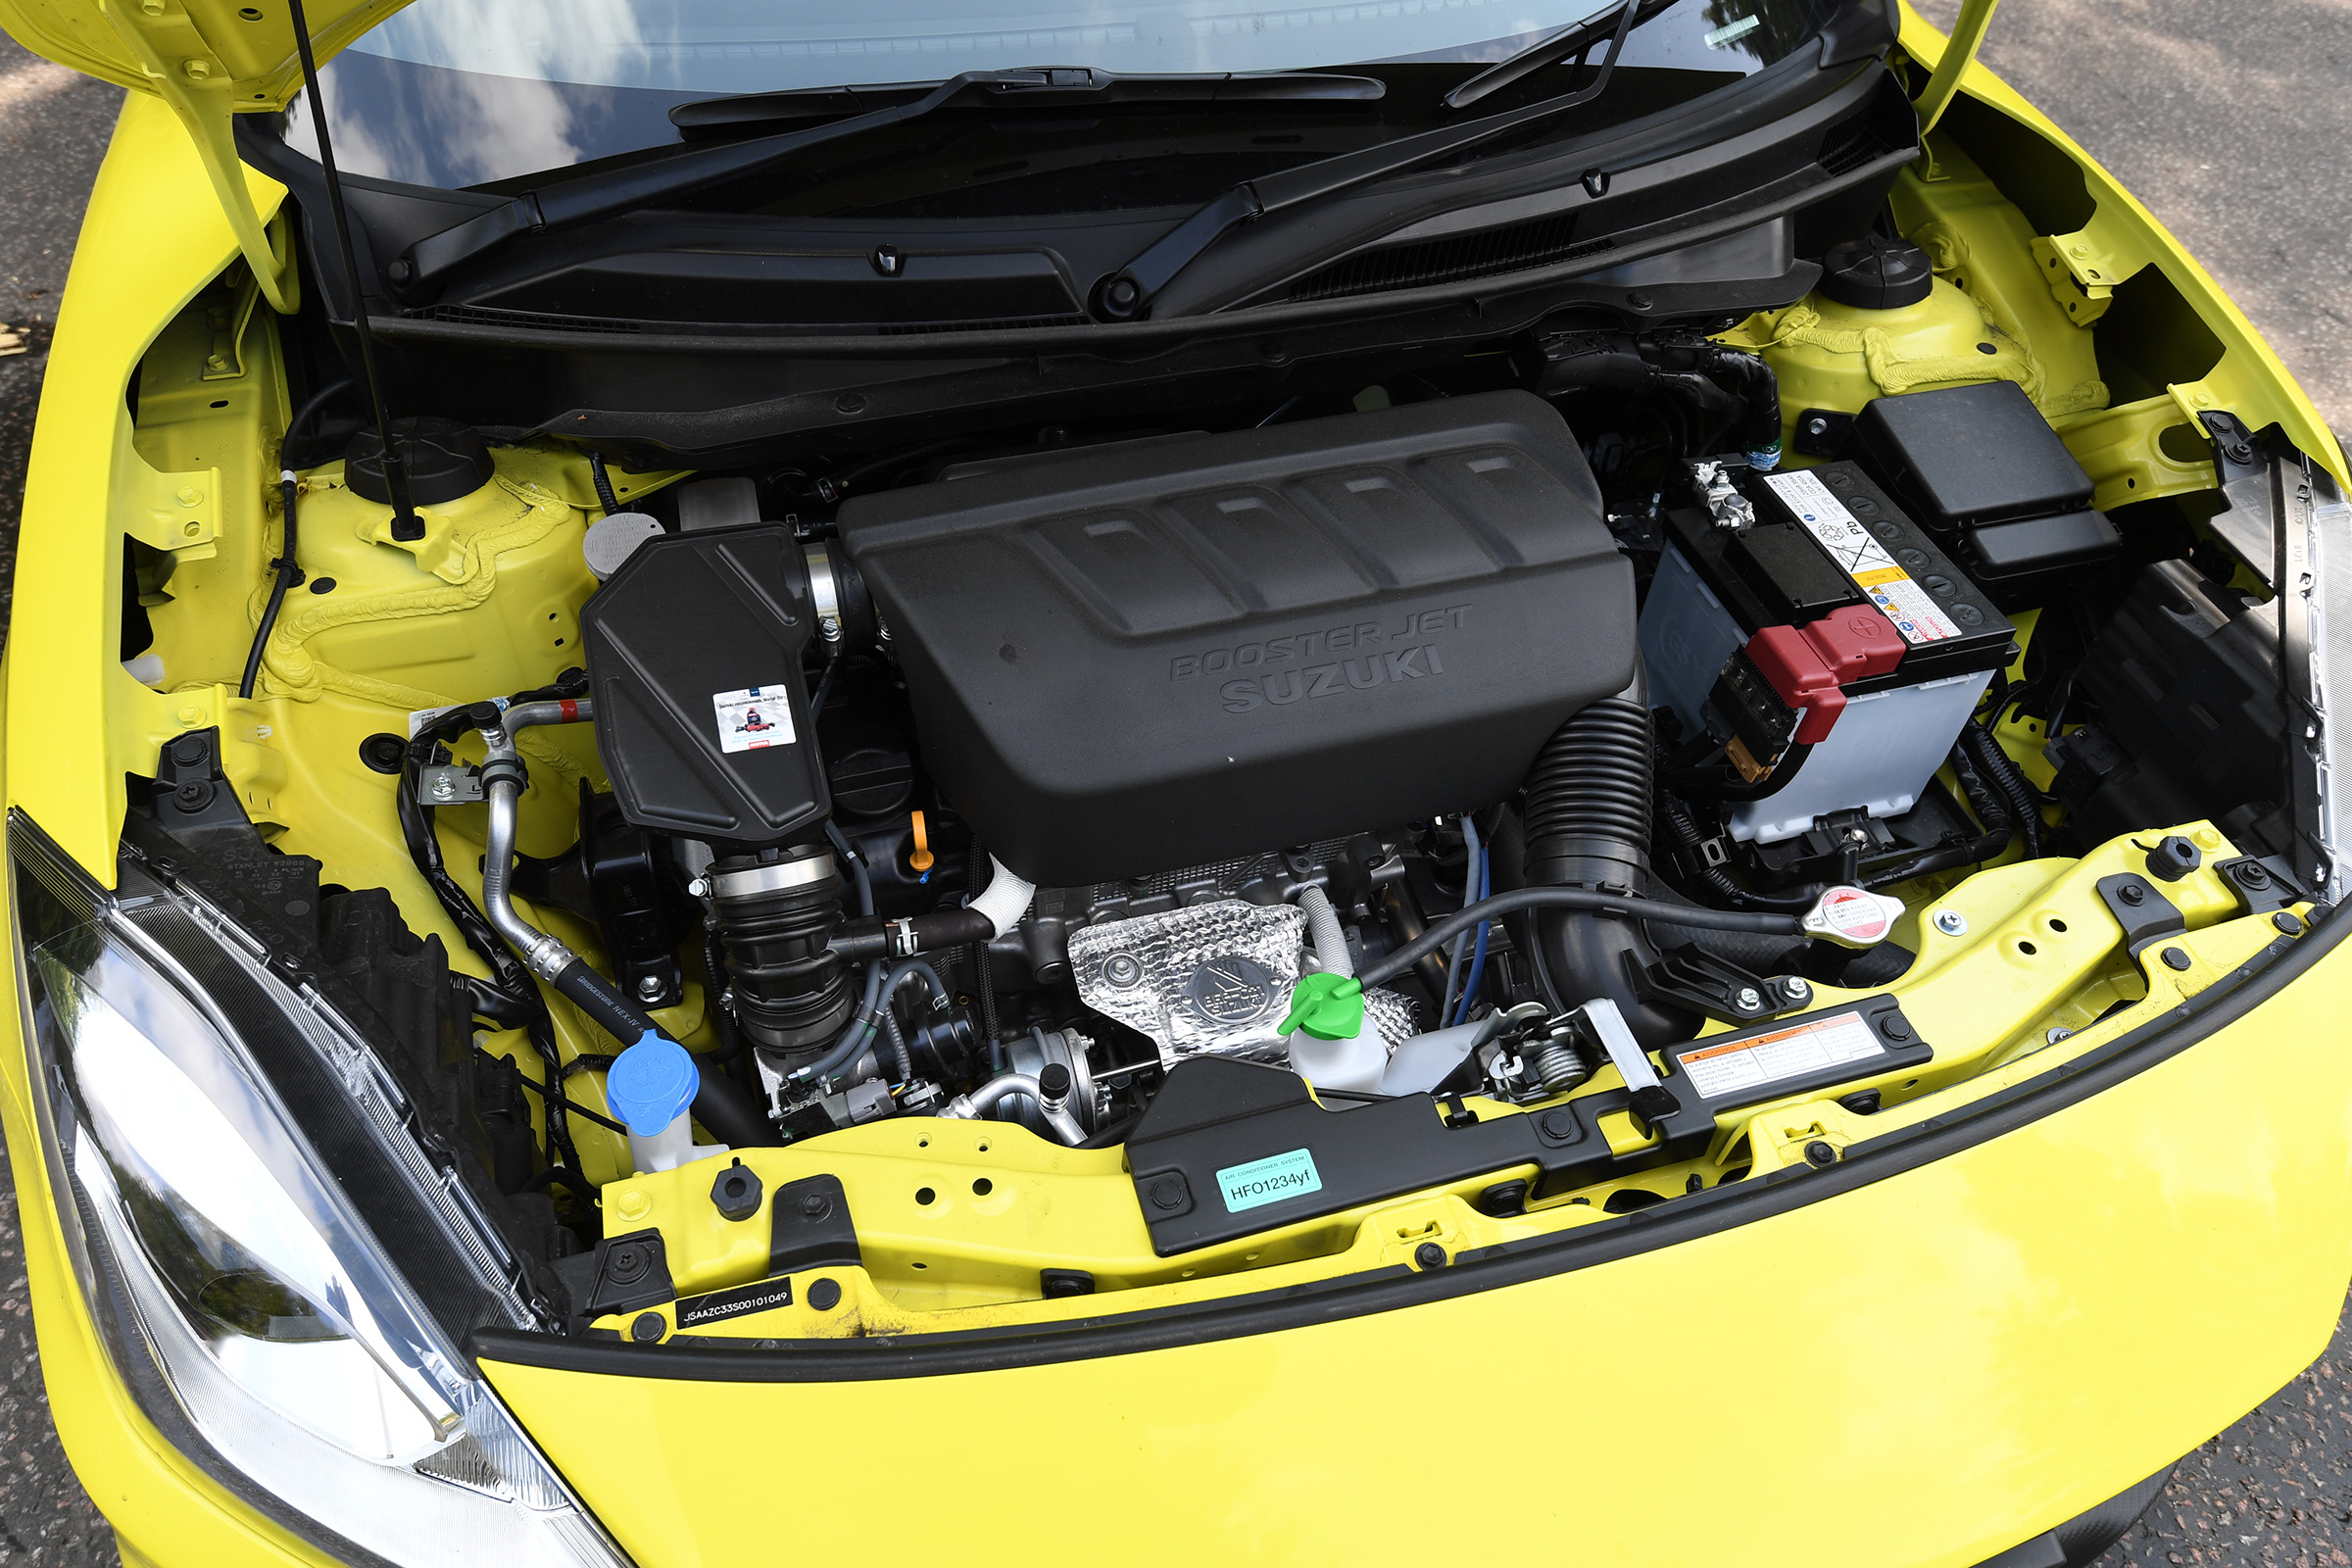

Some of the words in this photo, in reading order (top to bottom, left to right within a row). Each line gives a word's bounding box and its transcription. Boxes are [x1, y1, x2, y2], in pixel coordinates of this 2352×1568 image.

[1845, 520, 1864, 536] Pb
[1170, 621, 1385, 682] BOOSTER
[1392, 603, 1474, 641] JET
[1219, 643, 1445, 714] SUZUKI
[227, 860, 270, 870] STANLEY
[576, 975, 615, 1008] BRIDGESTONE
[612, 1004, 641, 1028] NEX-IV
[1702, 1045, 1737, 1058] ADVERTENCIA
[1237, 1162, 1279, 1177] CONDITIONER
[1280, 1155, 1305, 1166] SYSTEM
[1230, 1169, 1310, 1200] HFO1234yf
[683, 1292, 788, 1322] JSAAZC33S00101049
